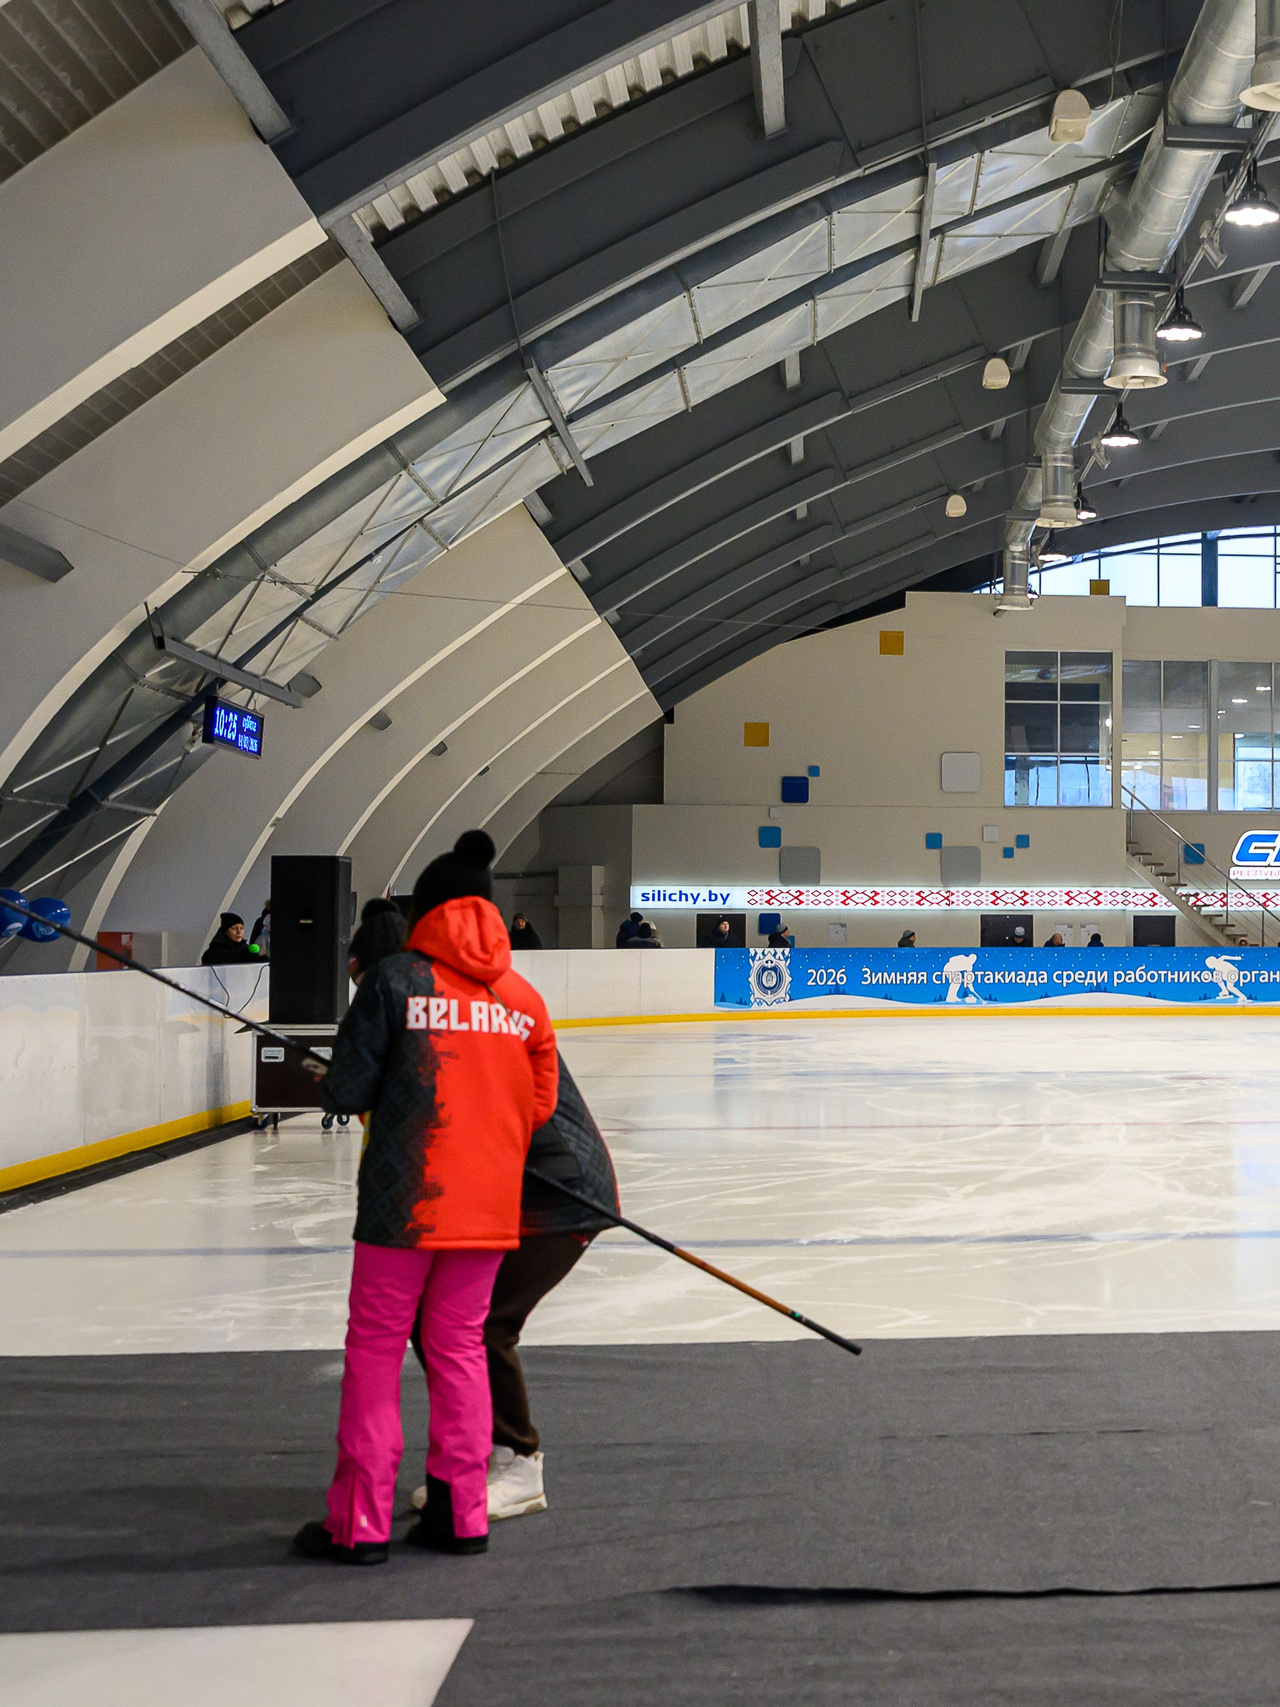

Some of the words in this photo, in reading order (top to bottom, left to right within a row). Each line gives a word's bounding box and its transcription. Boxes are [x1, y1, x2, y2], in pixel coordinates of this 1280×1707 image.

[641, 890, 730, 905] silichy.by
[806, 967, 848, 986] 2026
[861, 967, 928, 986] Зимняя
[931, 970, 1048, 988] спартакиада
[1052, 970, 1109, 988] среди
[1113, 965, 1224, 988] работников
[406, 995, 536, 1042] BELARUS
